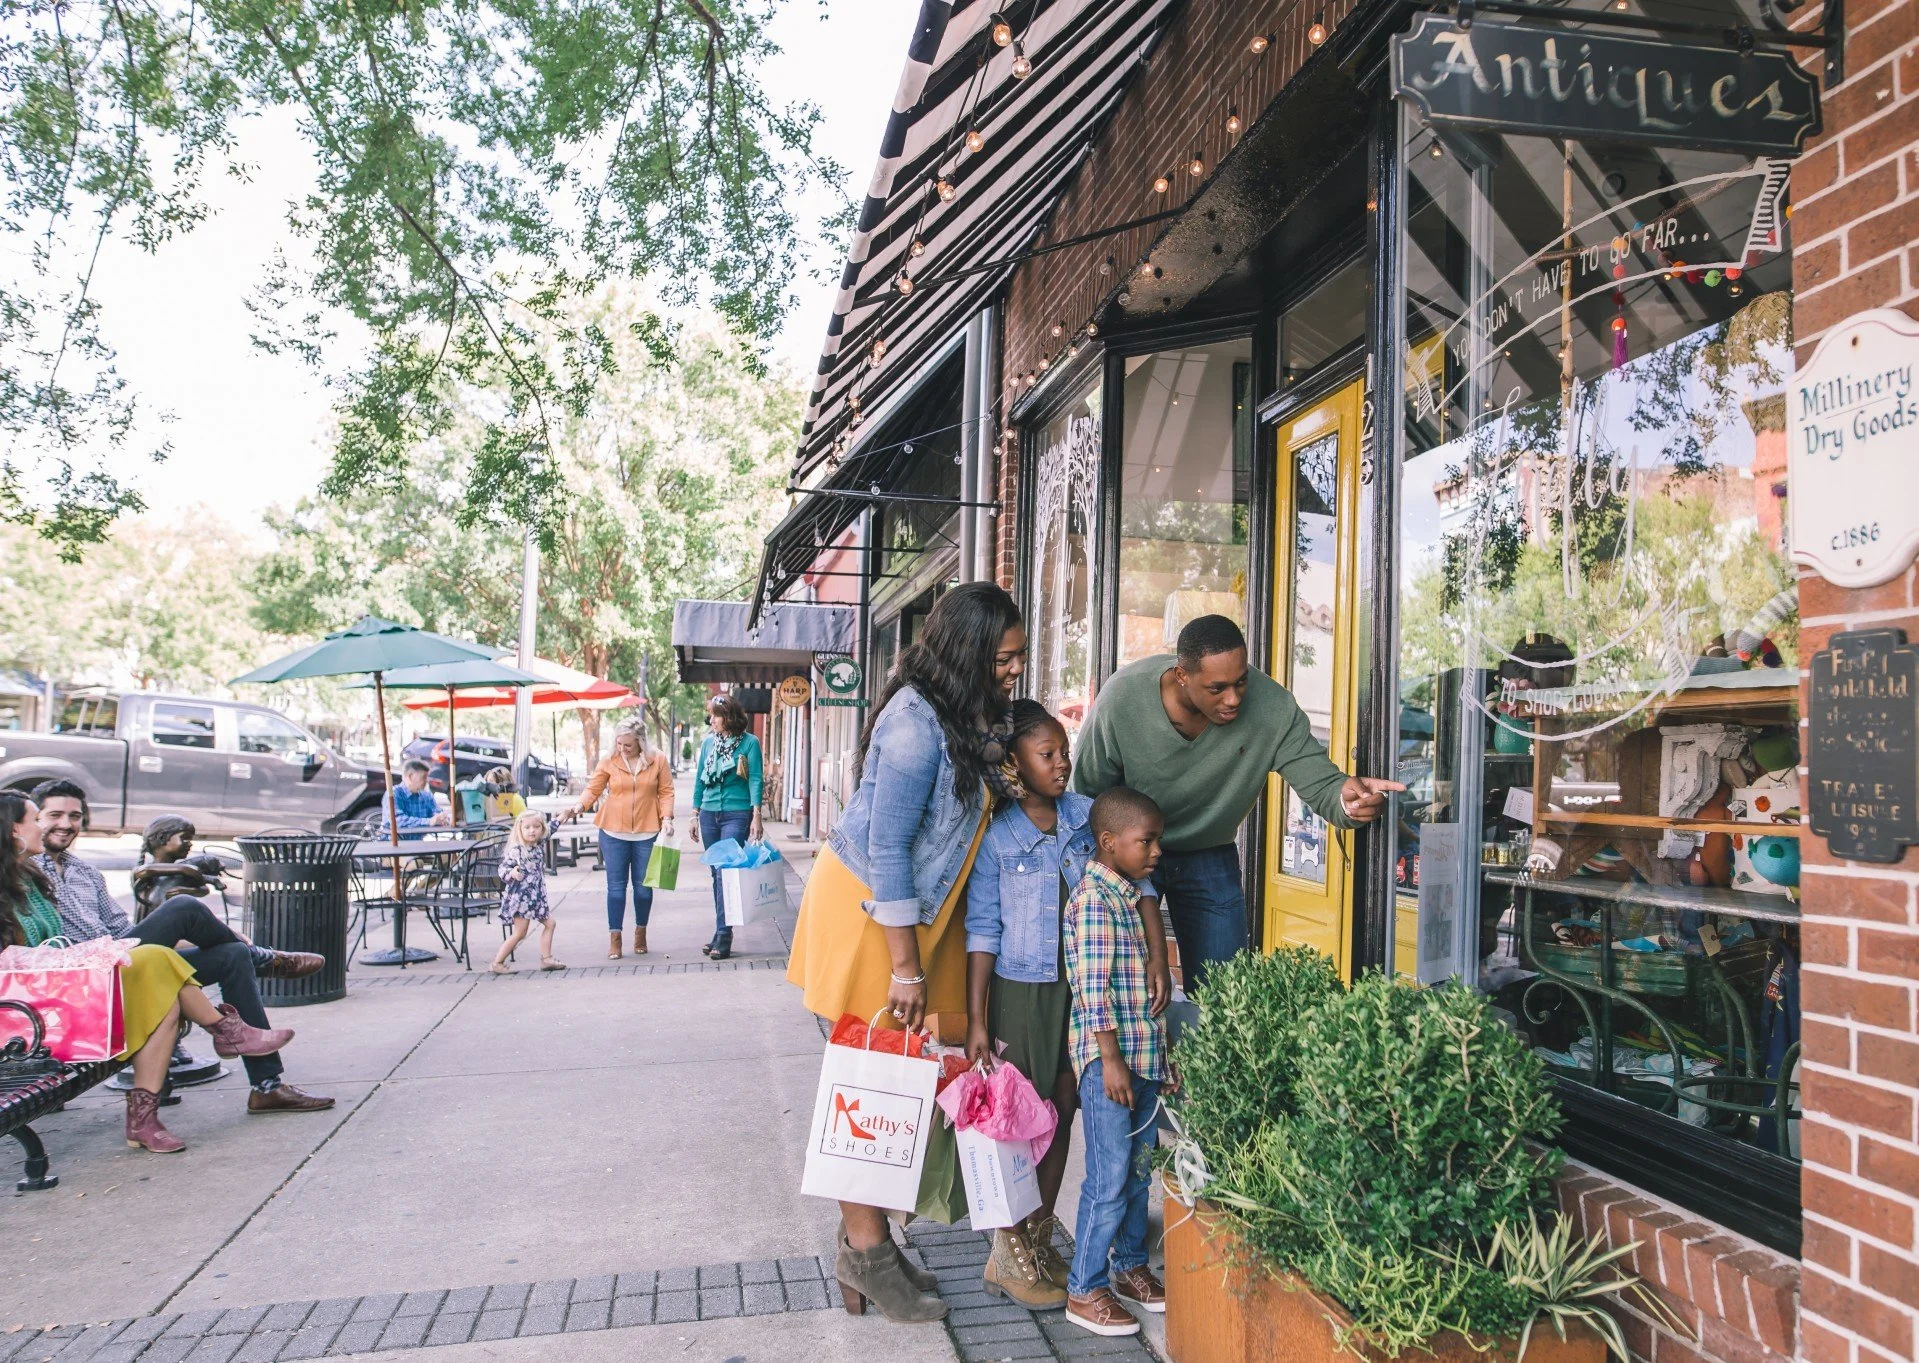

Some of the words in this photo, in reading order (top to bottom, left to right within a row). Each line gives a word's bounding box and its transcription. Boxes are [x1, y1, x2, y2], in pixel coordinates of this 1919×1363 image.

[1412, 32, 1808, 131] Antiques
[1484, 289, 1524, 340] DON'T
[1532, 257, 1568, 303] HAVE
[1580, 245, 1599, 276] TO
[1610, 231, 1631, 265] GO
[1642, 217, 1710, 253] FAR...
[1799, 363, 1913, 422] Millinery
[1804, 424, 1843, 461] Dry
[1853, 400, 1919, 443] Goods
[783, 687, 807, 695] HARP
[1500, 677, 1517, 707] TO
[1525, 688, 1562, 716] SHOP
[829, 1137, 910, 1161] SHOES
[987, 1154, 999, 1198] Downtown
